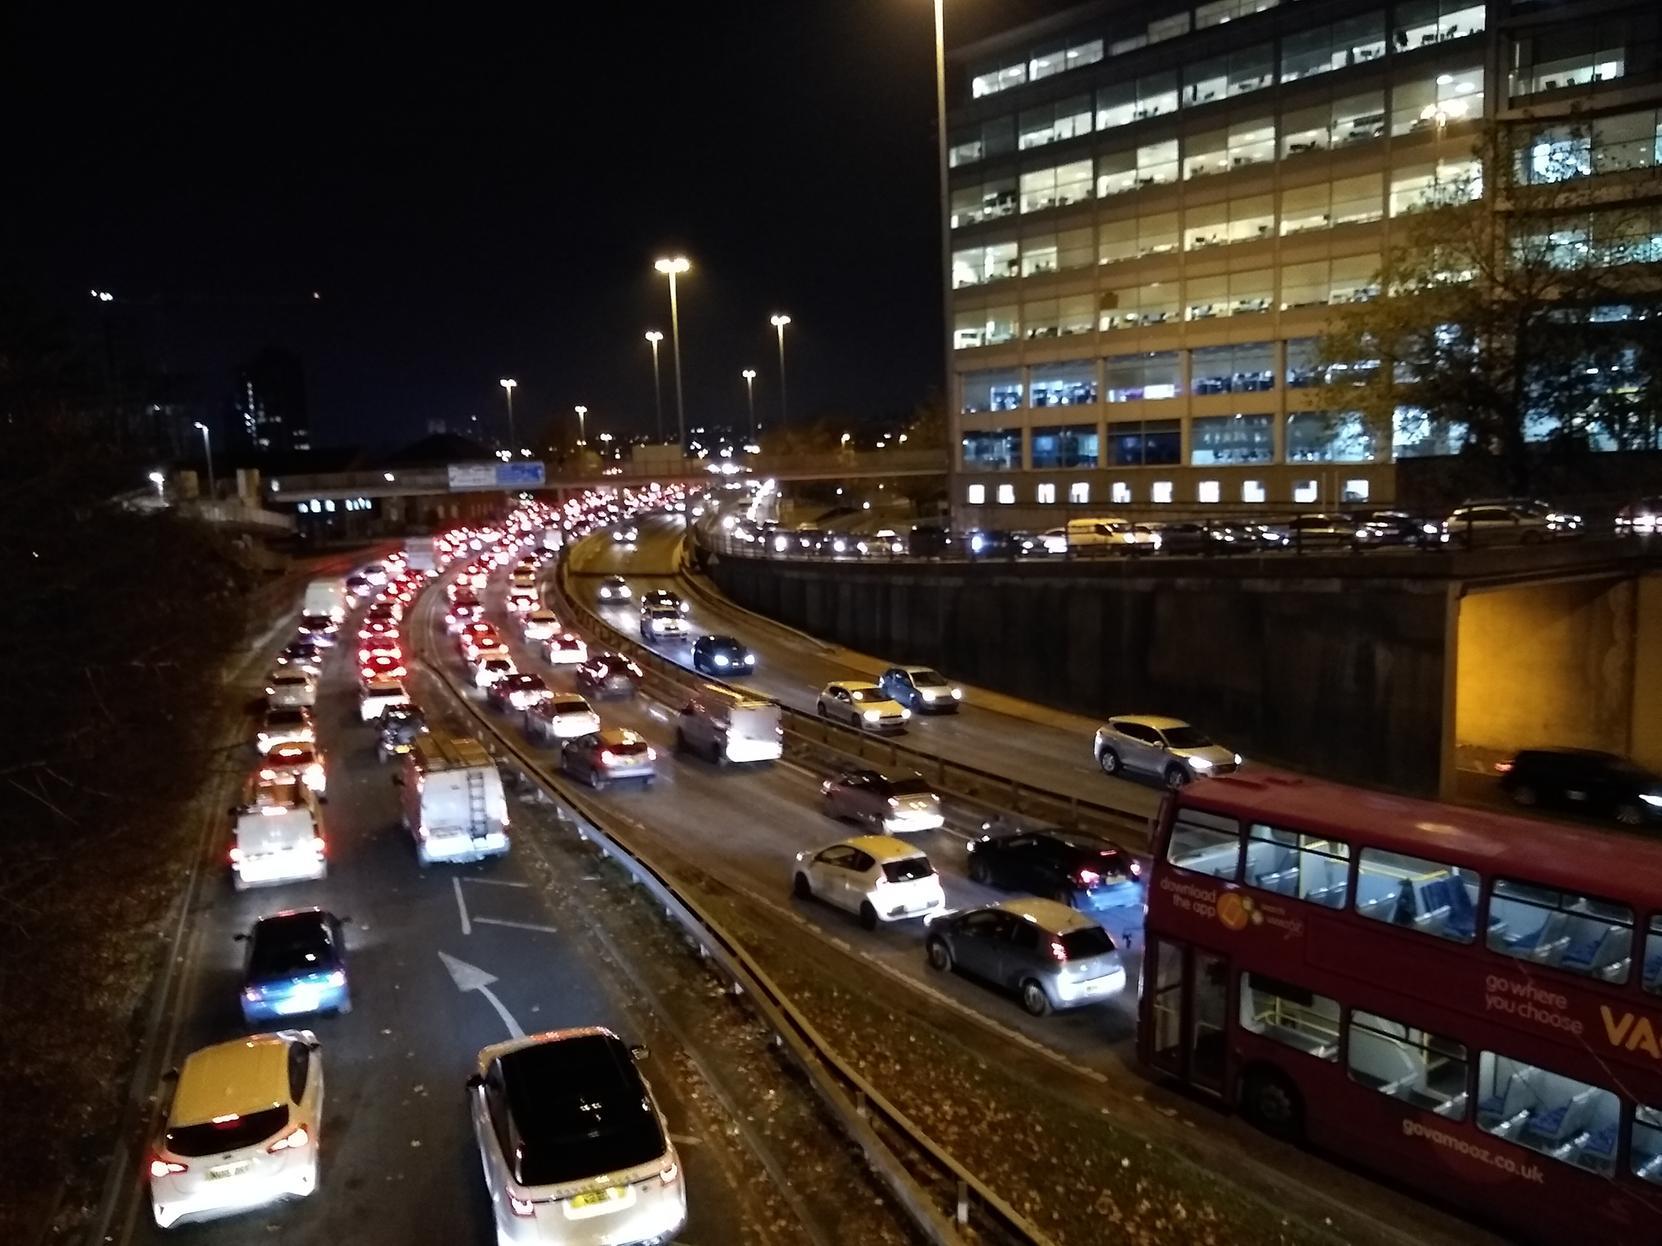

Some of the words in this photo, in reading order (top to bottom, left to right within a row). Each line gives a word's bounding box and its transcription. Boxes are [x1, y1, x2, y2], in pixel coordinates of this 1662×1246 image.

[1160, 877, 1216, 903] download
[1173, 894, 1191, 911] the
[1193, 902, 1216, 918] app
[1486, 975, 1509, 992] go
[1511, 981, 1568, 1009] where
[1485, 994, 1515, 1013] you
[1518, 1002, 1584, 1034] choose
[1600, 1005, 1662, 1059] VA
[1402, 1119, 1544, 1183] govamooz.co.uk
